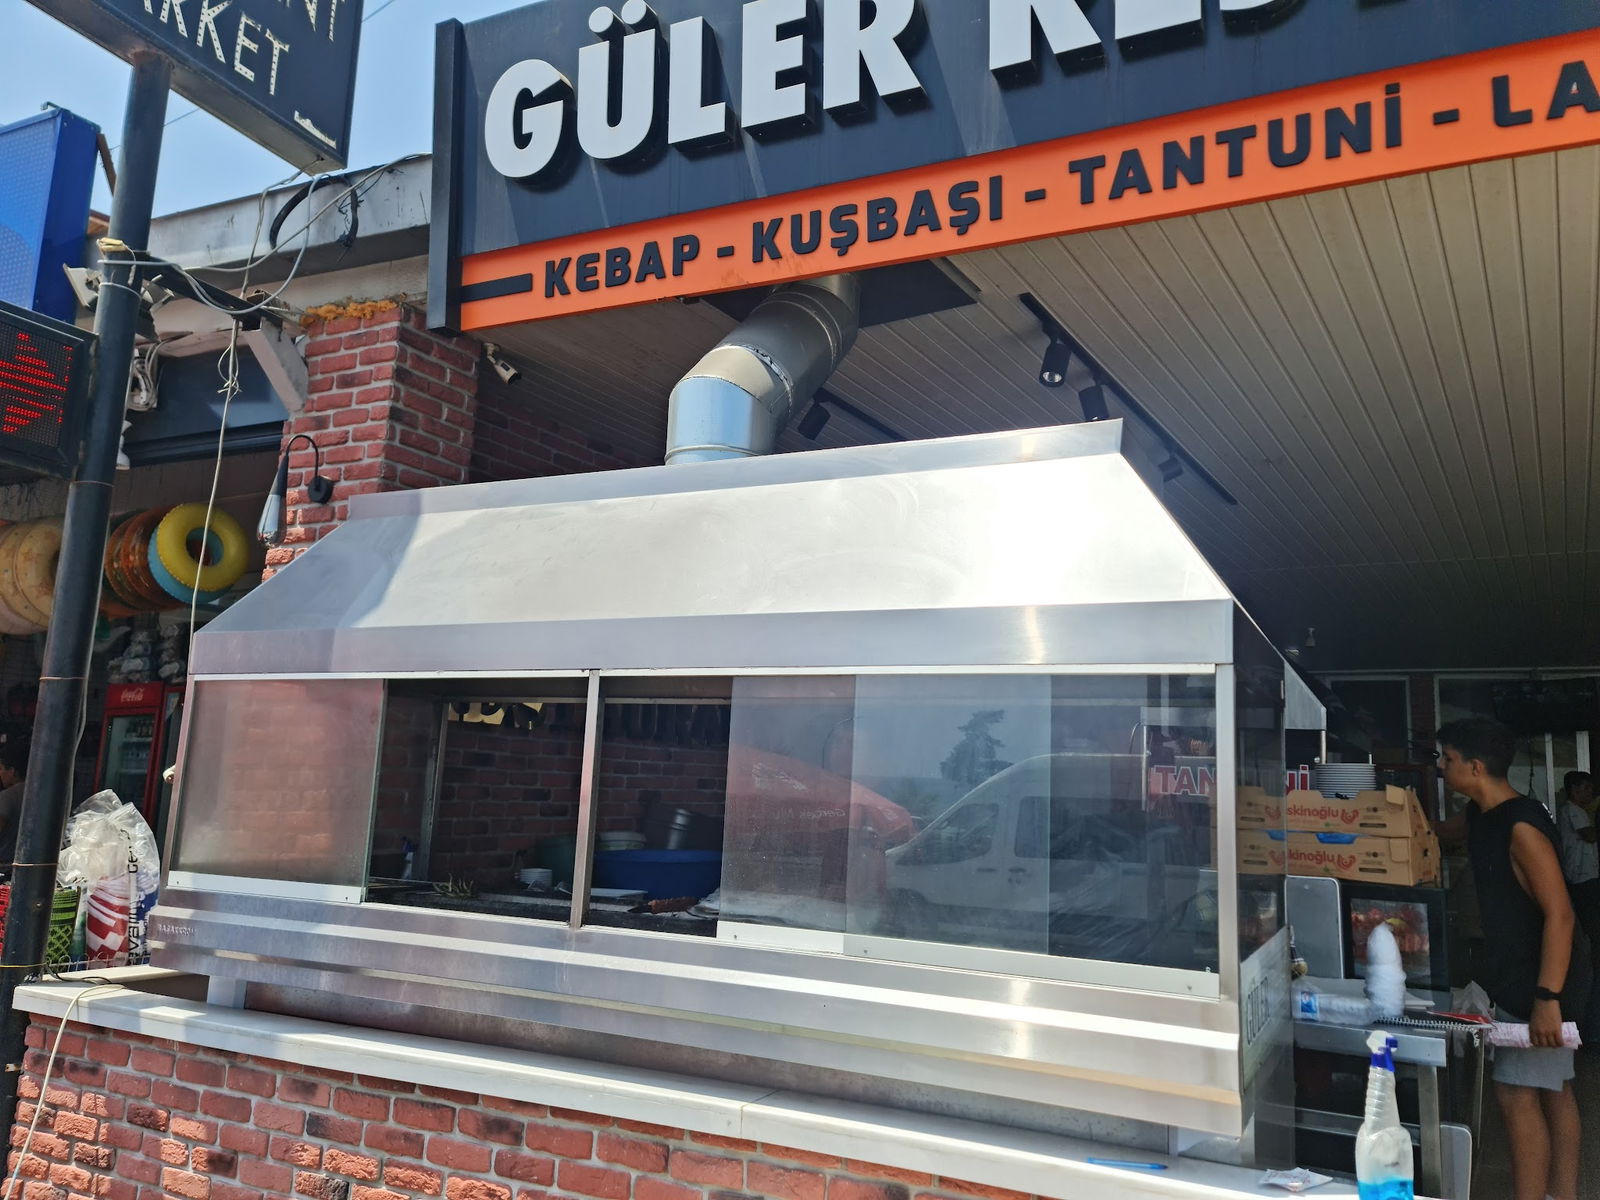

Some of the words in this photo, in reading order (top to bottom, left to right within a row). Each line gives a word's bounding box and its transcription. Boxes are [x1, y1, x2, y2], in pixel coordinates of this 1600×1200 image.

[484, 0, 923, 178] GÜLER
[544, 234, 700, 299] KEBAP
[752, 175, 1003, 263] KUŞBAŞI
[1068, 83, 1402, 205] TANTUNİ
[1287, 803, 1339, 820] skinoğlu
[1288, 849, 1335, 865] kinoğlu
